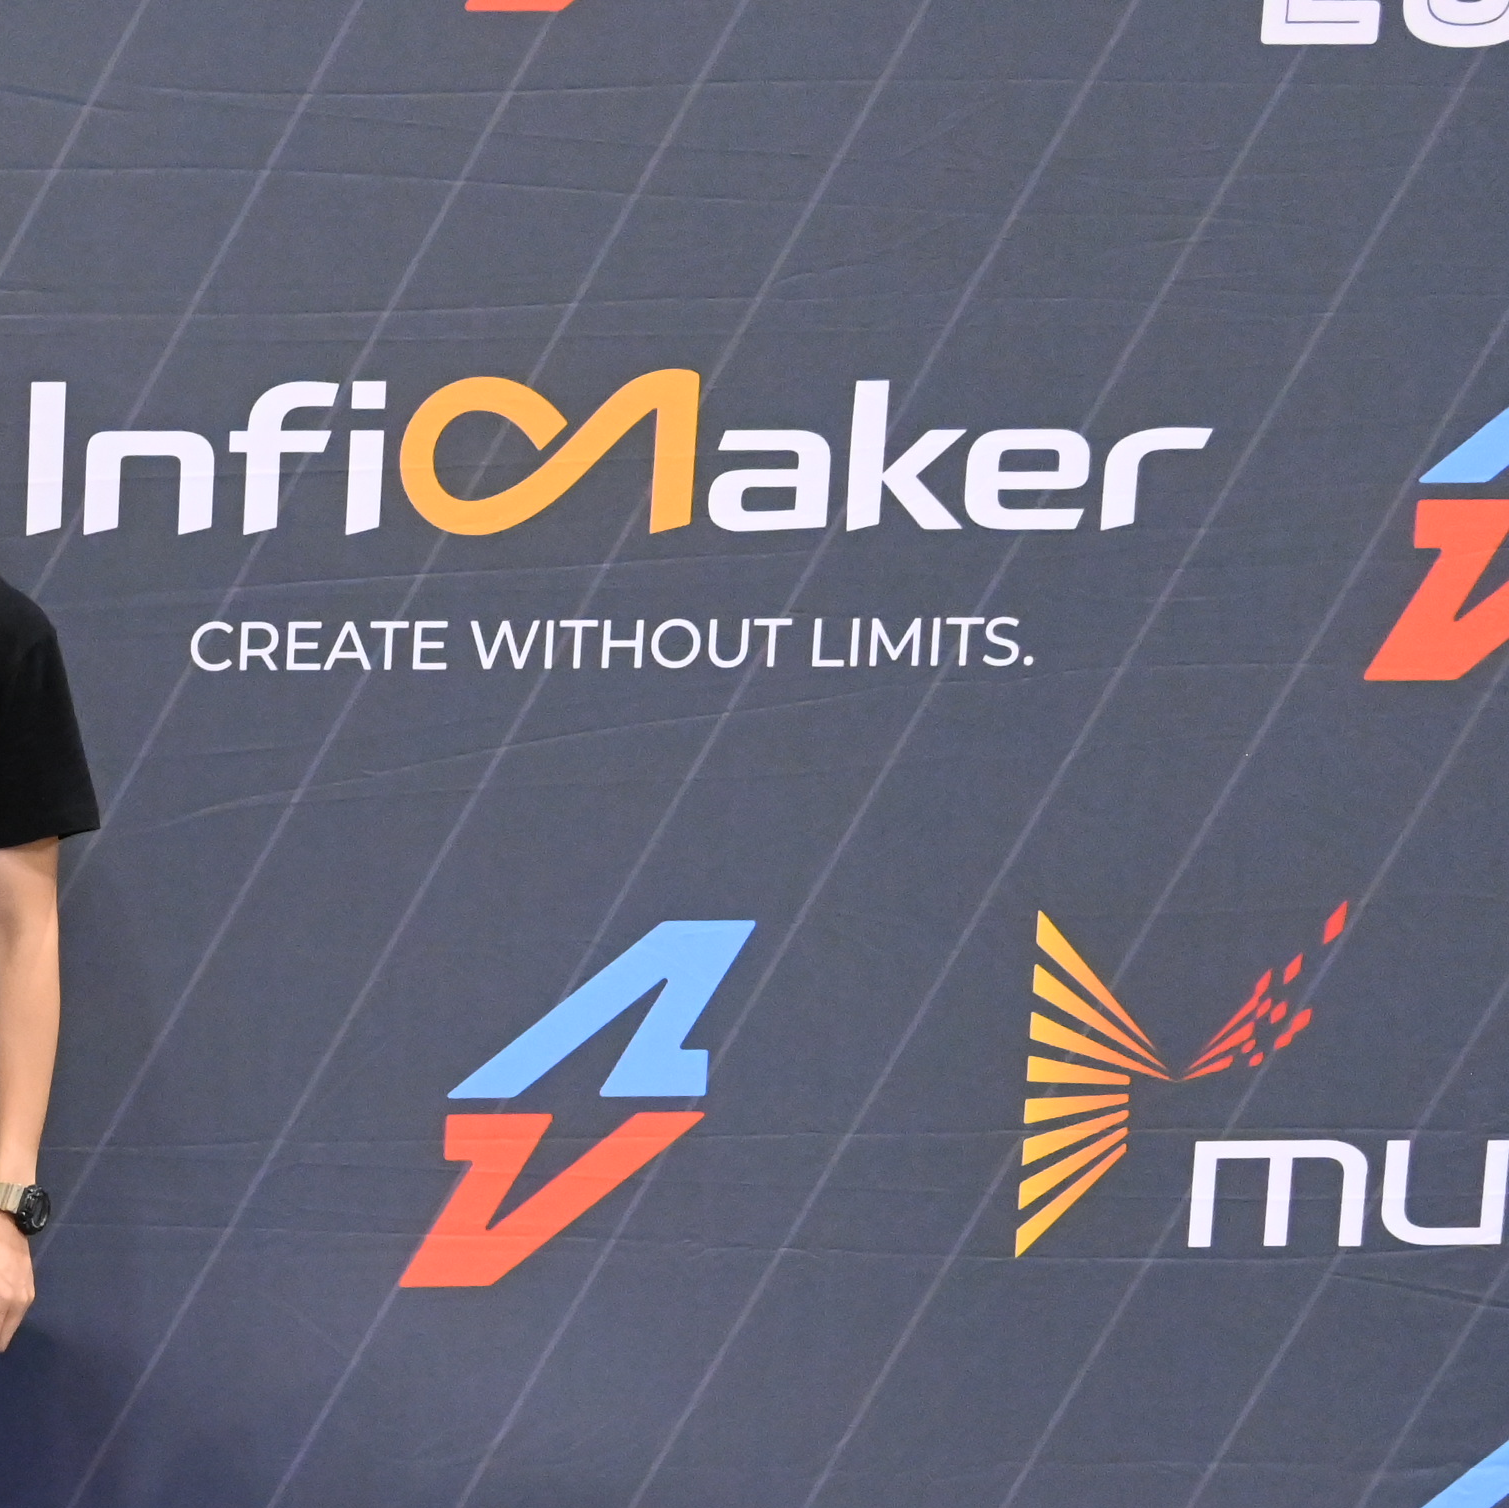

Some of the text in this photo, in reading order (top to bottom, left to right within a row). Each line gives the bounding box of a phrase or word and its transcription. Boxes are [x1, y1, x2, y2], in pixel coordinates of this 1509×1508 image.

[190, 616, 1034, 672] CREATE WITHOUT LIMITS.
